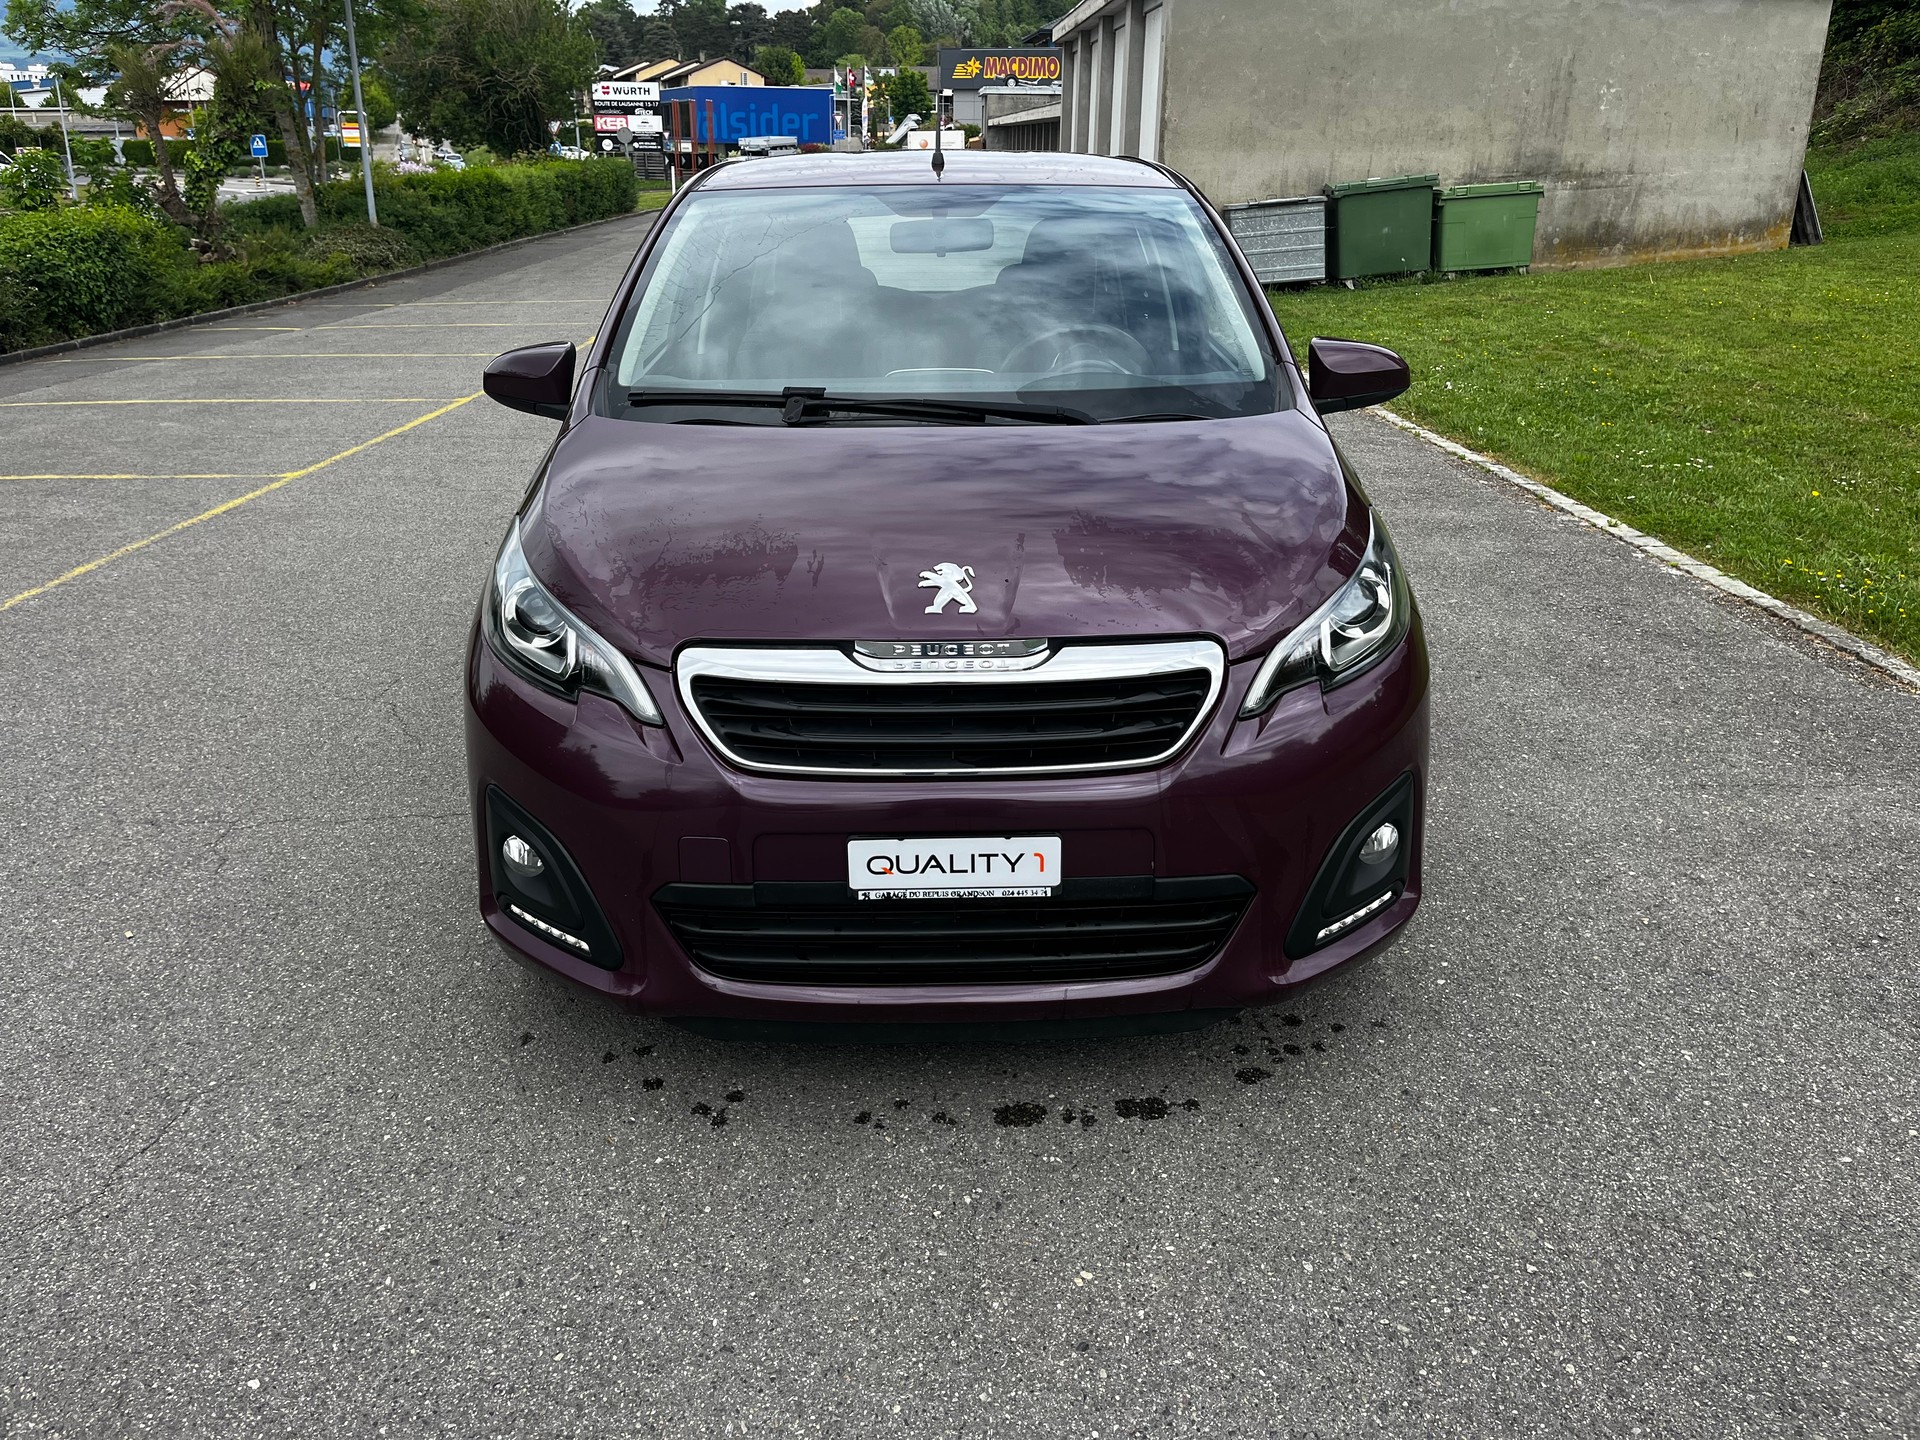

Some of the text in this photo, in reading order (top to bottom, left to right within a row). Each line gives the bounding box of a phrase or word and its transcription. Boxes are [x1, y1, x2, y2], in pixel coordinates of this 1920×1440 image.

[983, 56, 1060, 79] MACDIMO
[612, 86, 651, 96] WÜRTH
[696, 102, 819, 140] alsider
[893, 643, 1010, 655] PEUGEOT
[866, 852, 1026, 875] QUALITY
[875, 891, 908, 899] GARAGE
